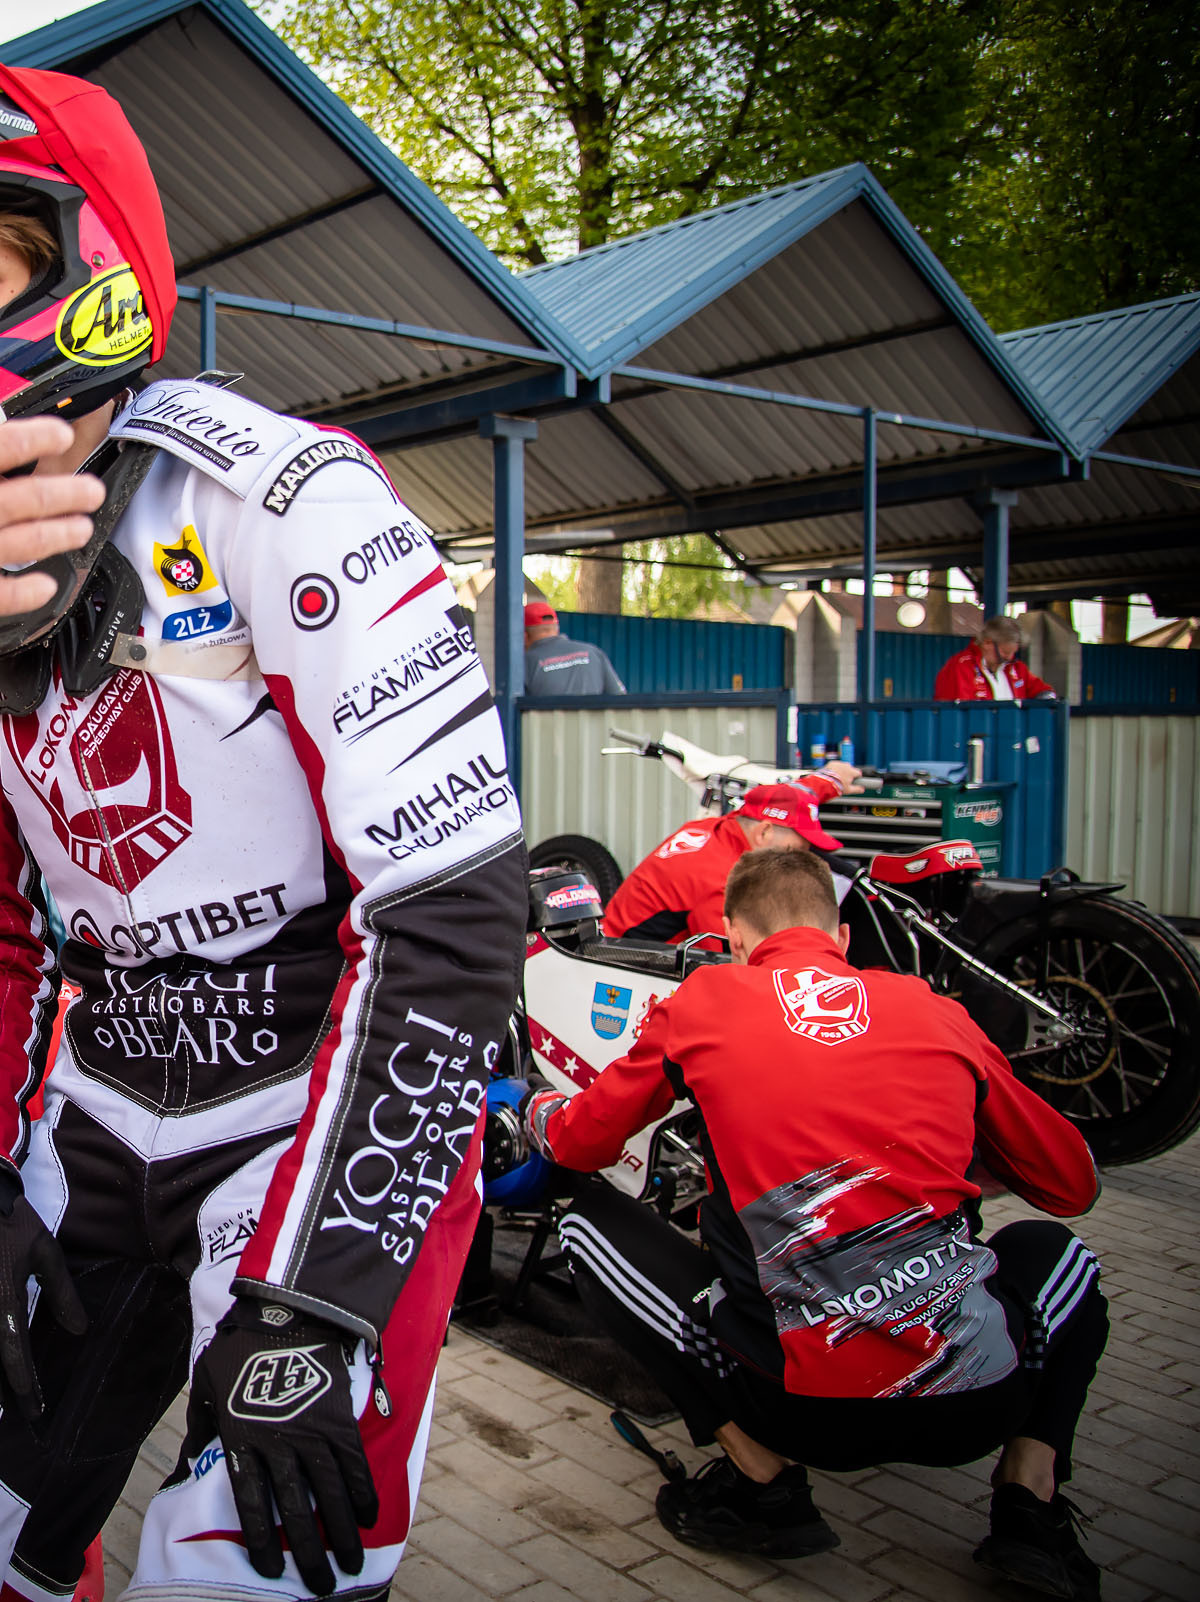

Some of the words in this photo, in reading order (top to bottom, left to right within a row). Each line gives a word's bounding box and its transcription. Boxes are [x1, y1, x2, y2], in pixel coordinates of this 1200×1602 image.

[73, 284, 149, 350] Ara
[97, 610, 125, 660] SIX.FIVE
[173, 608, 214, 638] 2LŻ
[371, 666, 388, 681] UN
[393, 627, 449, 666] TELPAUGI
[79, 668, 132, 743] DAUGAVPIL
[83, 702, 124, 759] SPEEDWAY
[122, 674, 143, 703] CLUB
[91, 994, 276, 1016] GASTROBĀRS
[110, 1016, 256, 1067] BEAR
[320, 1007, 458, 1235] YOGGI
[207, 1218, 234, 1241] ZIEDI
[237, 1208, 253, 1220] UN
[885, 1264, 975, 1322] DAUGAVPILS
[889, 1301, 950, 1337] SPEEDWAY
